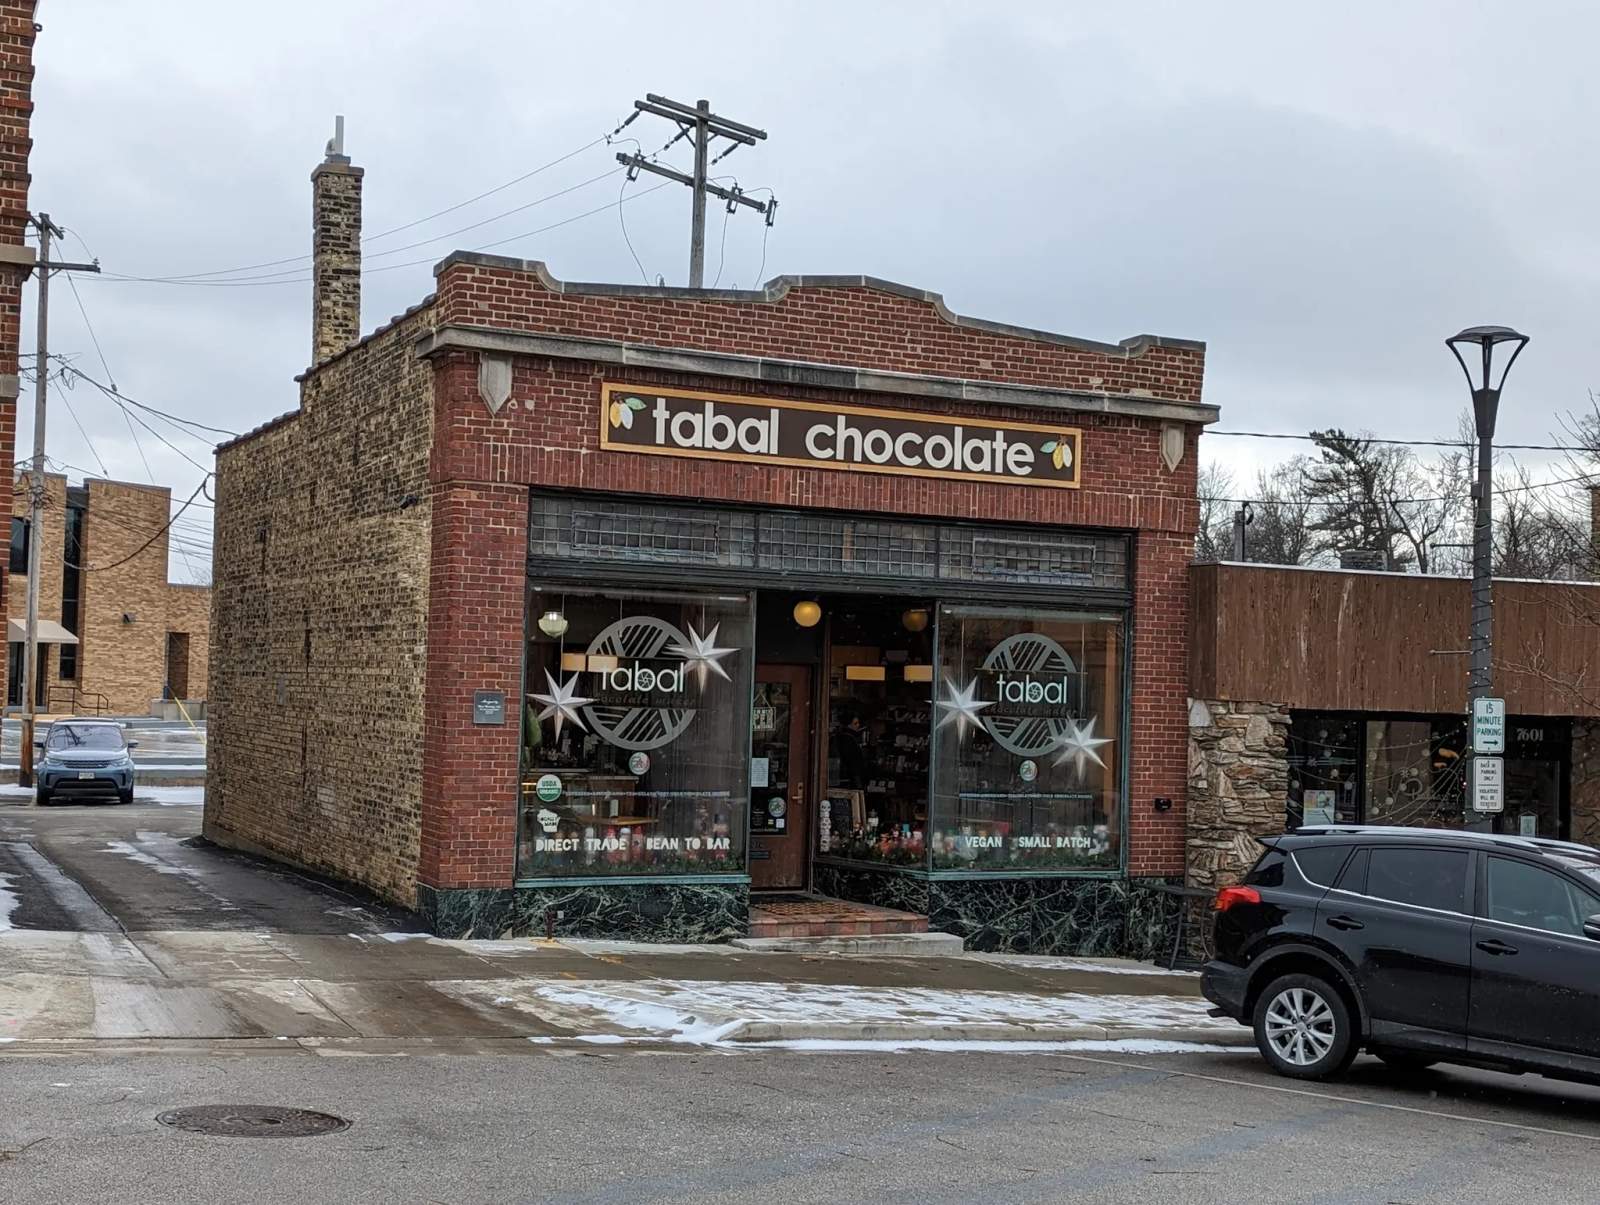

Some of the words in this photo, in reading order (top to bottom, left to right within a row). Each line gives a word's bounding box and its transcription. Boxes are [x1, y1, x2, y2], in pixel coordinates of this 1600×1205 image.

[653, 397, 779, 455] tabal
[805, 415, 1035, 475] chocolate
[996, 673, 1068, 704] tabal
[1486, 704, 1494, 714] 15
[1476, 716, 1502, 725] MINUTE
[1476, 727, 1502, 736] PARKING
[1517, 727, 1544, 741] 7601
[536, 838, 580, 852] DIRECT
[586, 838, 628, 852] TRADE
[646, 837, 679, 850] BEAN
[684, 837, 701, 850] TO
[706, 837, 731, 850] BAR
[965, 836, 1003, 848] VEGAN
[1019, 836, 1052, 848] SMALL
[1056, 836, 1092, 849] BATCH
